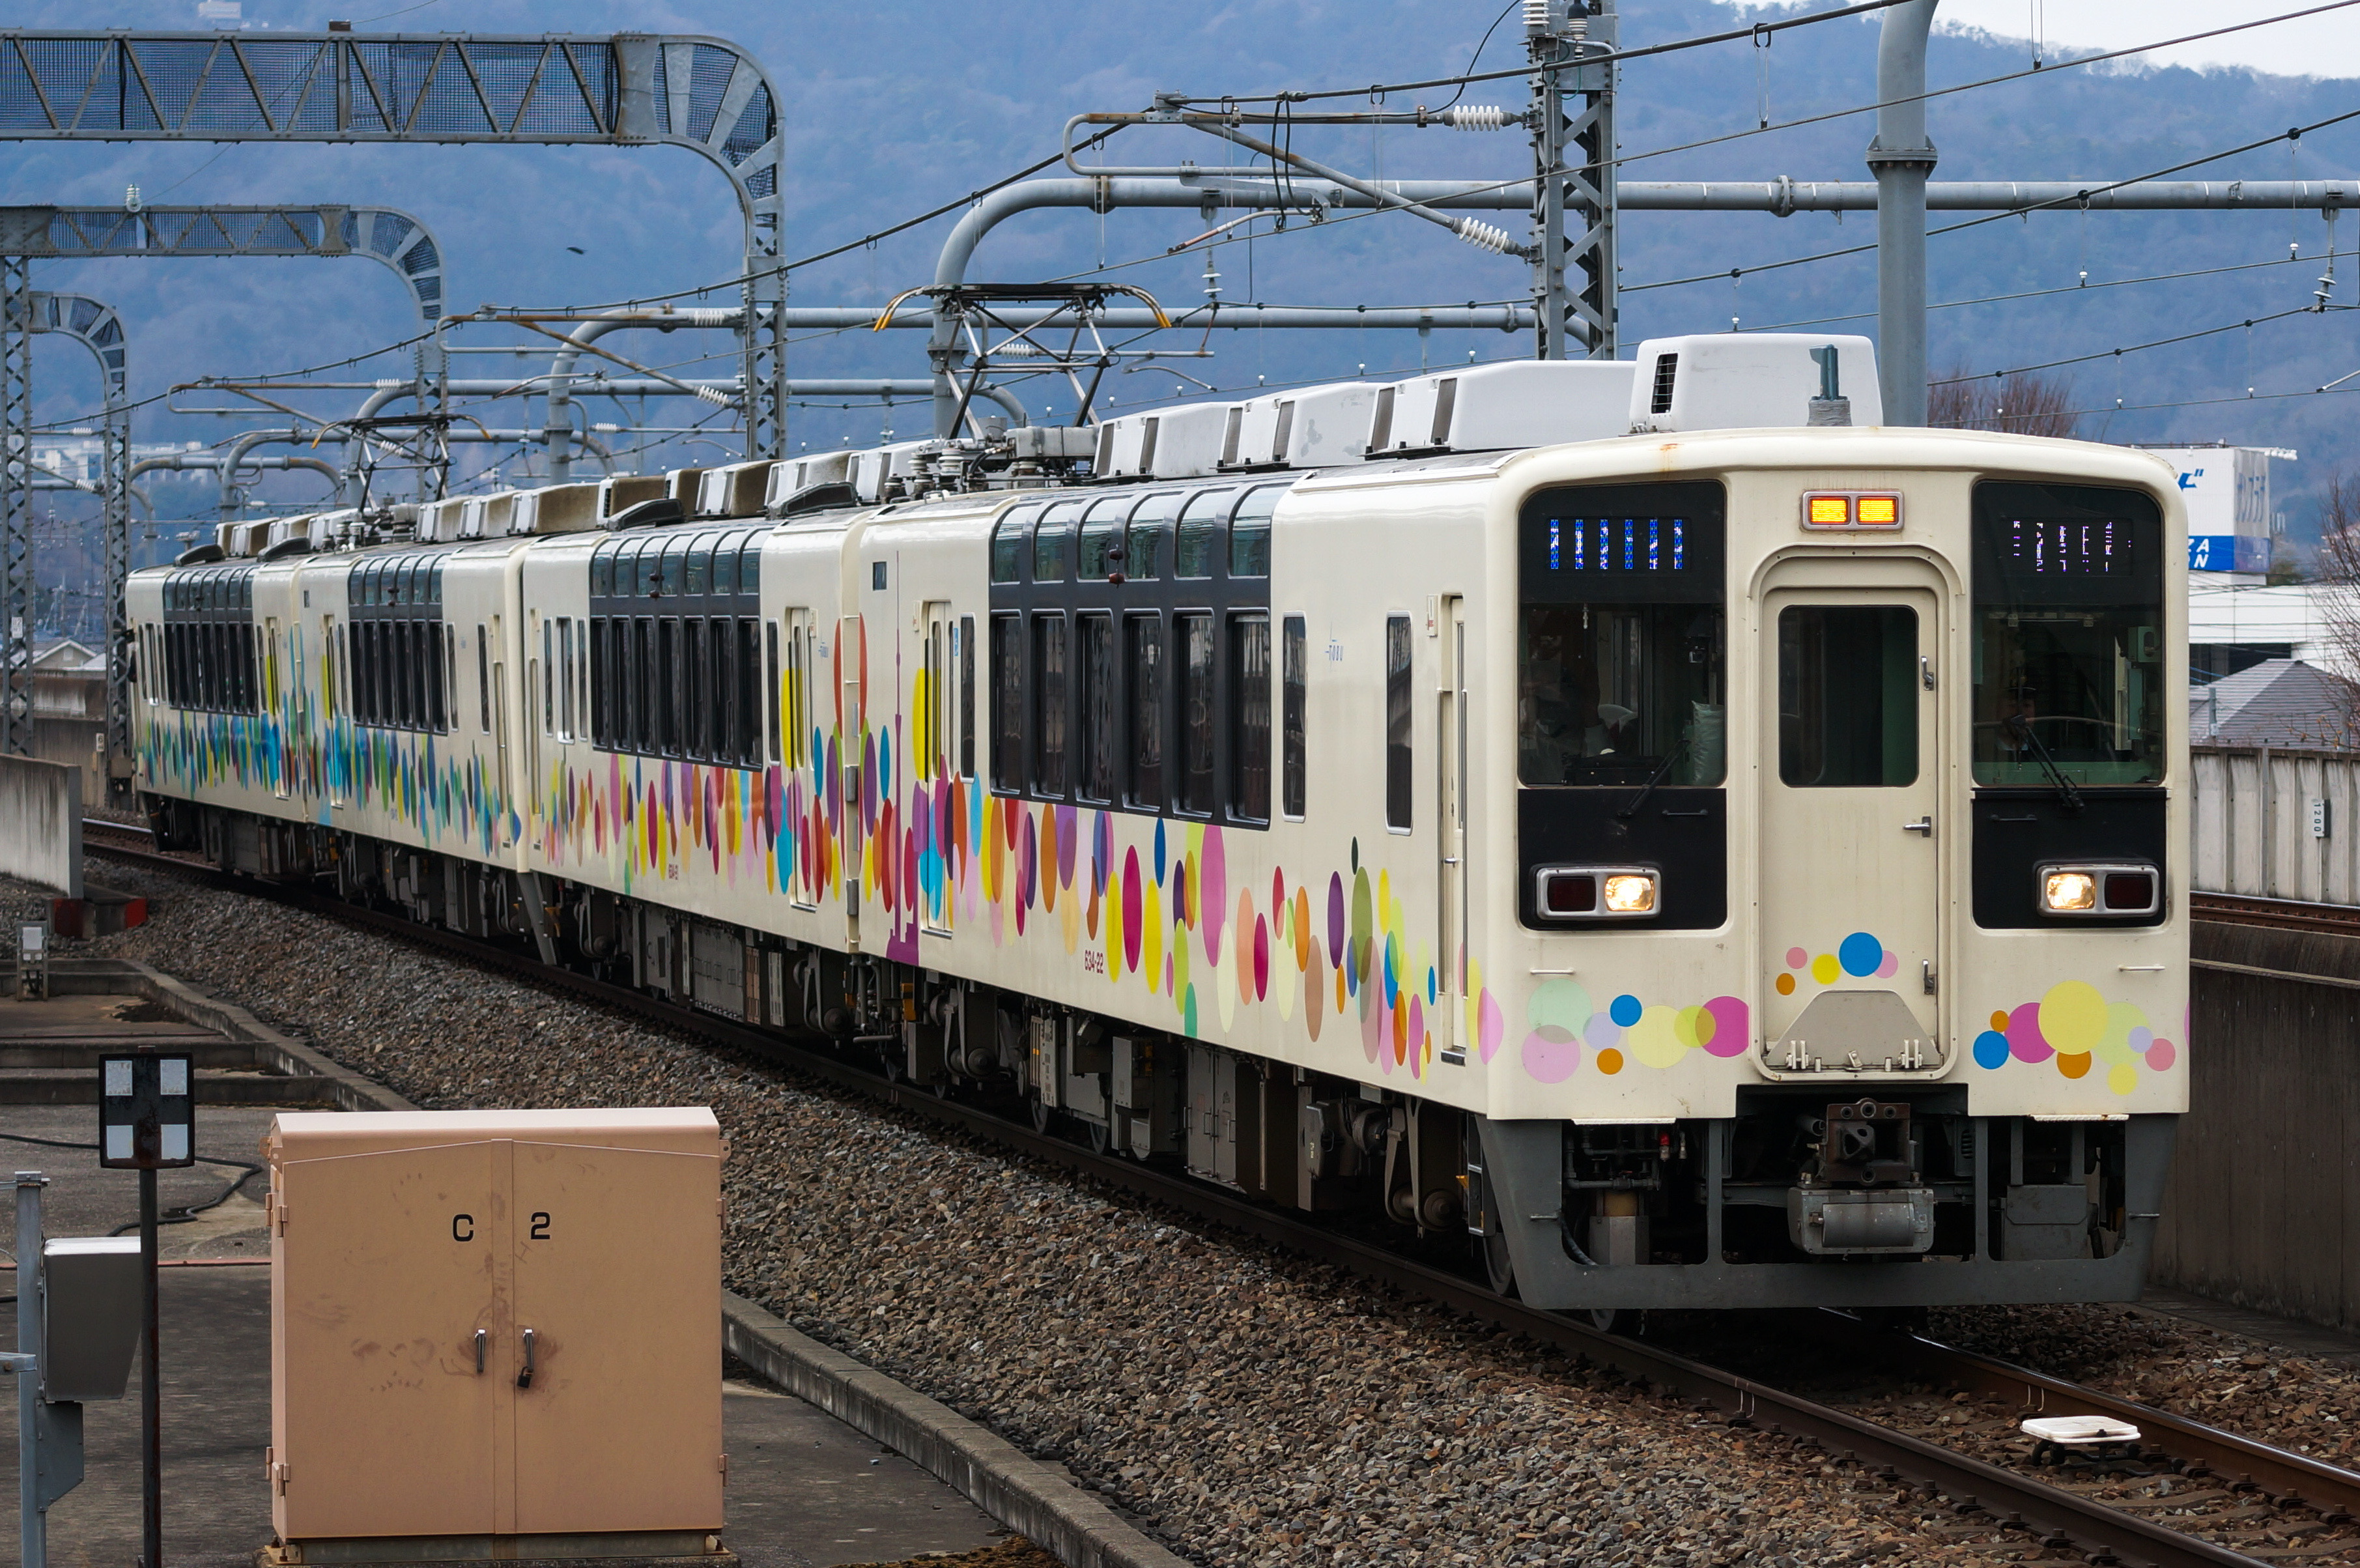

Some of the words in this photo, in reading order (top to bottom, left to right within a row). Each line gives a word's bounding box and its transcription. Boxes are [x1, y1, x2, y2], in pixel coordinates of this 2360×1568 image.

[1085, 949, 1103, 974] 634-22
[452, 1214, 474, 1242] C
[530, 1212, 550, 1240] 2
